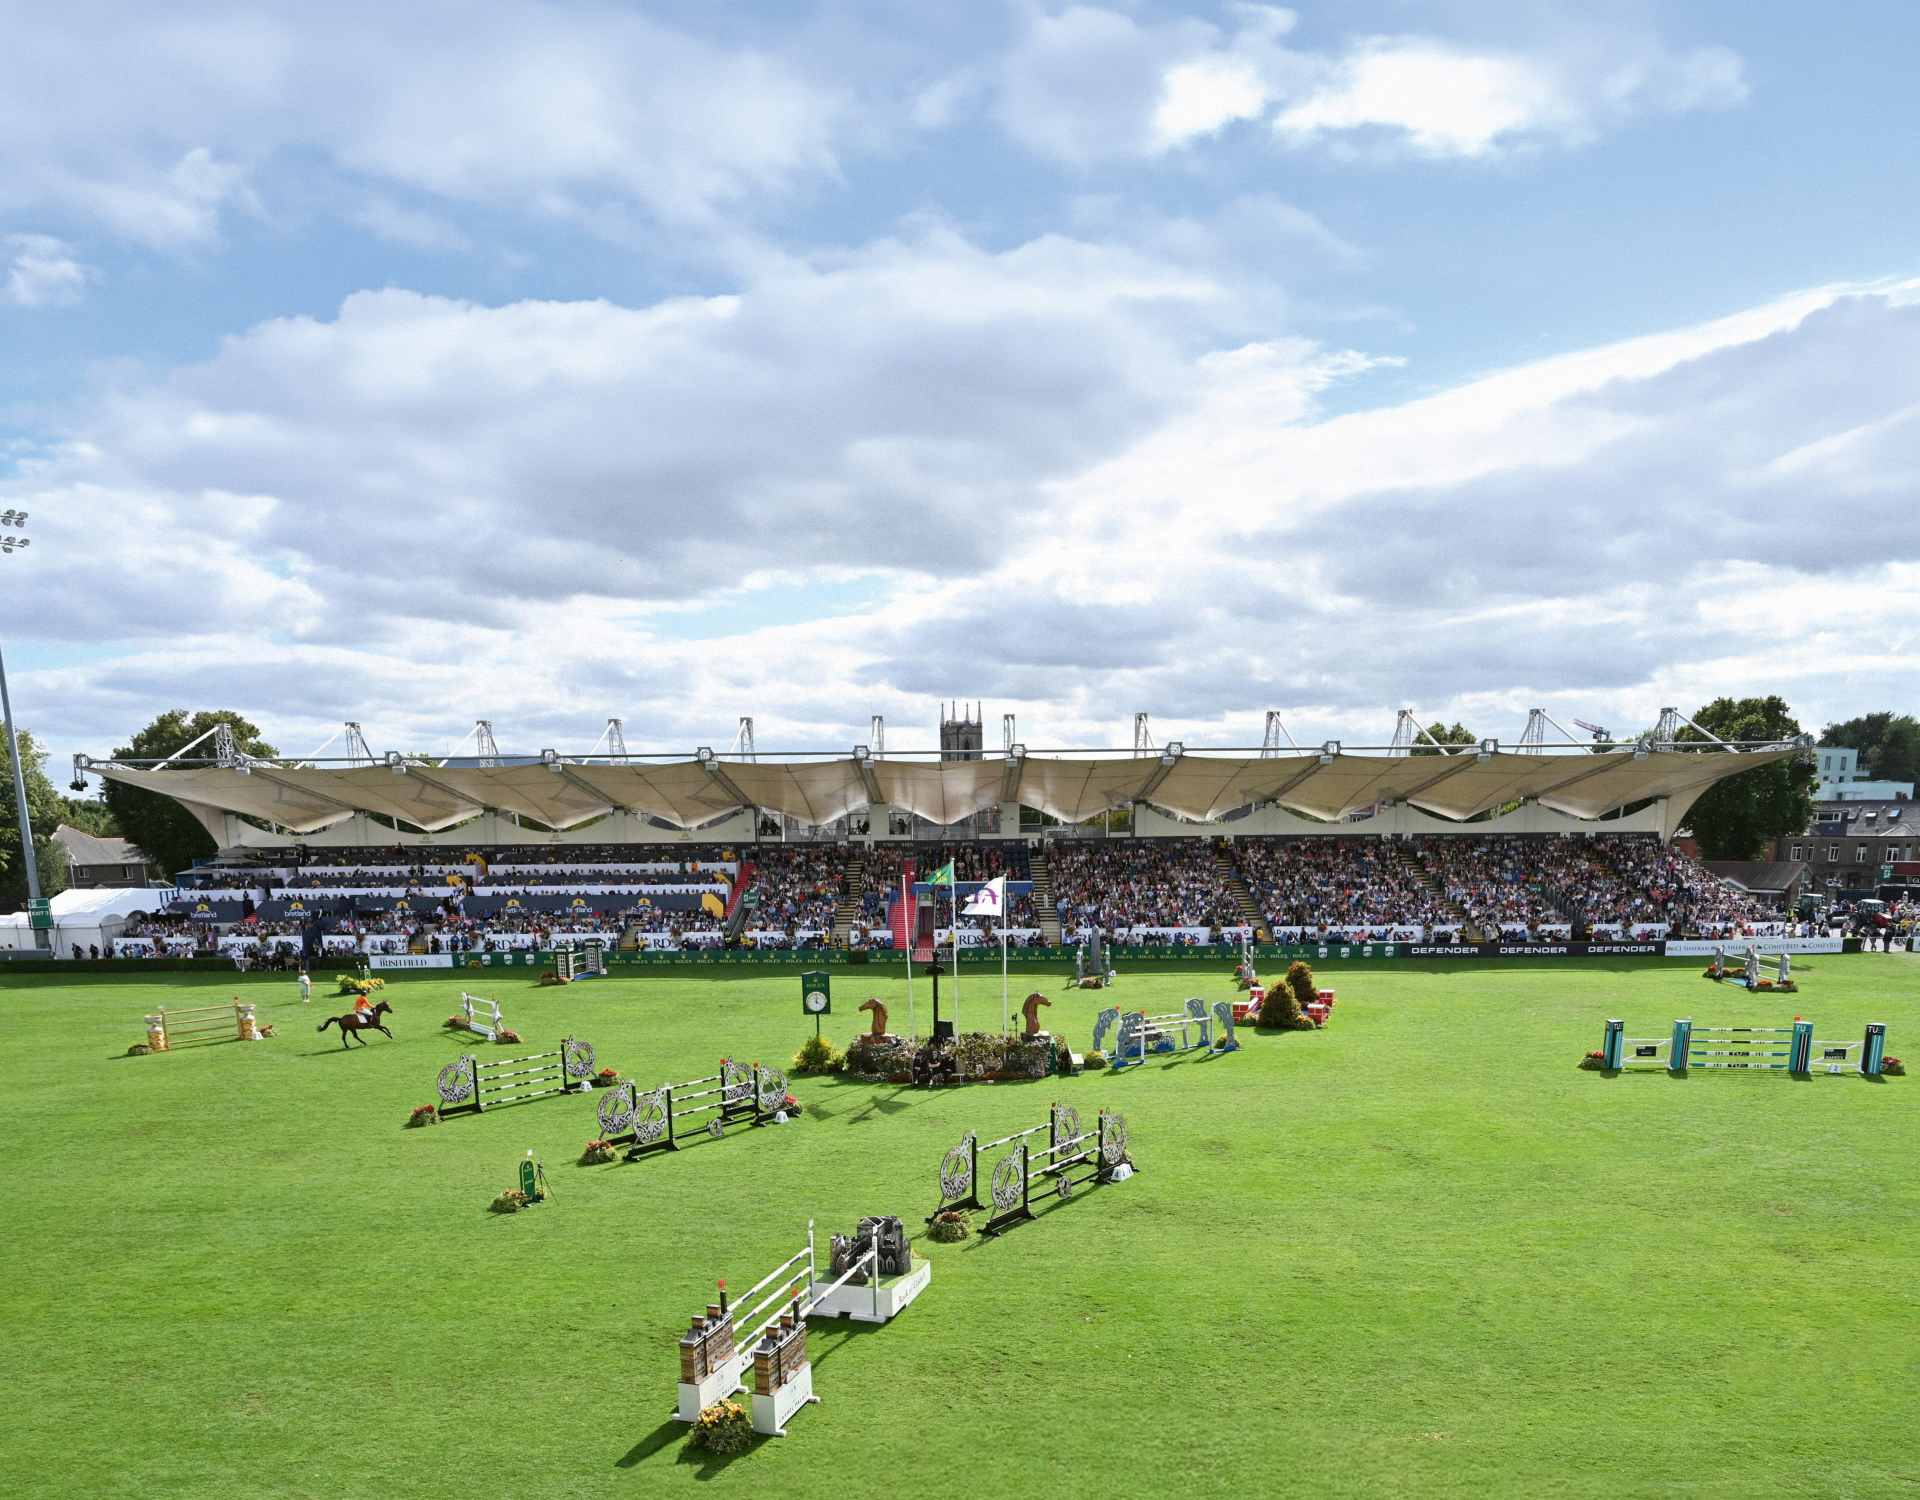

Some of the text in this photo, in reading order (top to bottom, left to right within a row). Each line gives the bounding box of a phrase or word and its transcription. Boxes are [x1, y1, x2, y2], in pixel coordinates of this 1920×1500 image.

[653, 938, 672, 949] RD
[959, 934, 981, 945] RDS
[1588, 945, 1655, 953] DEFENDER
